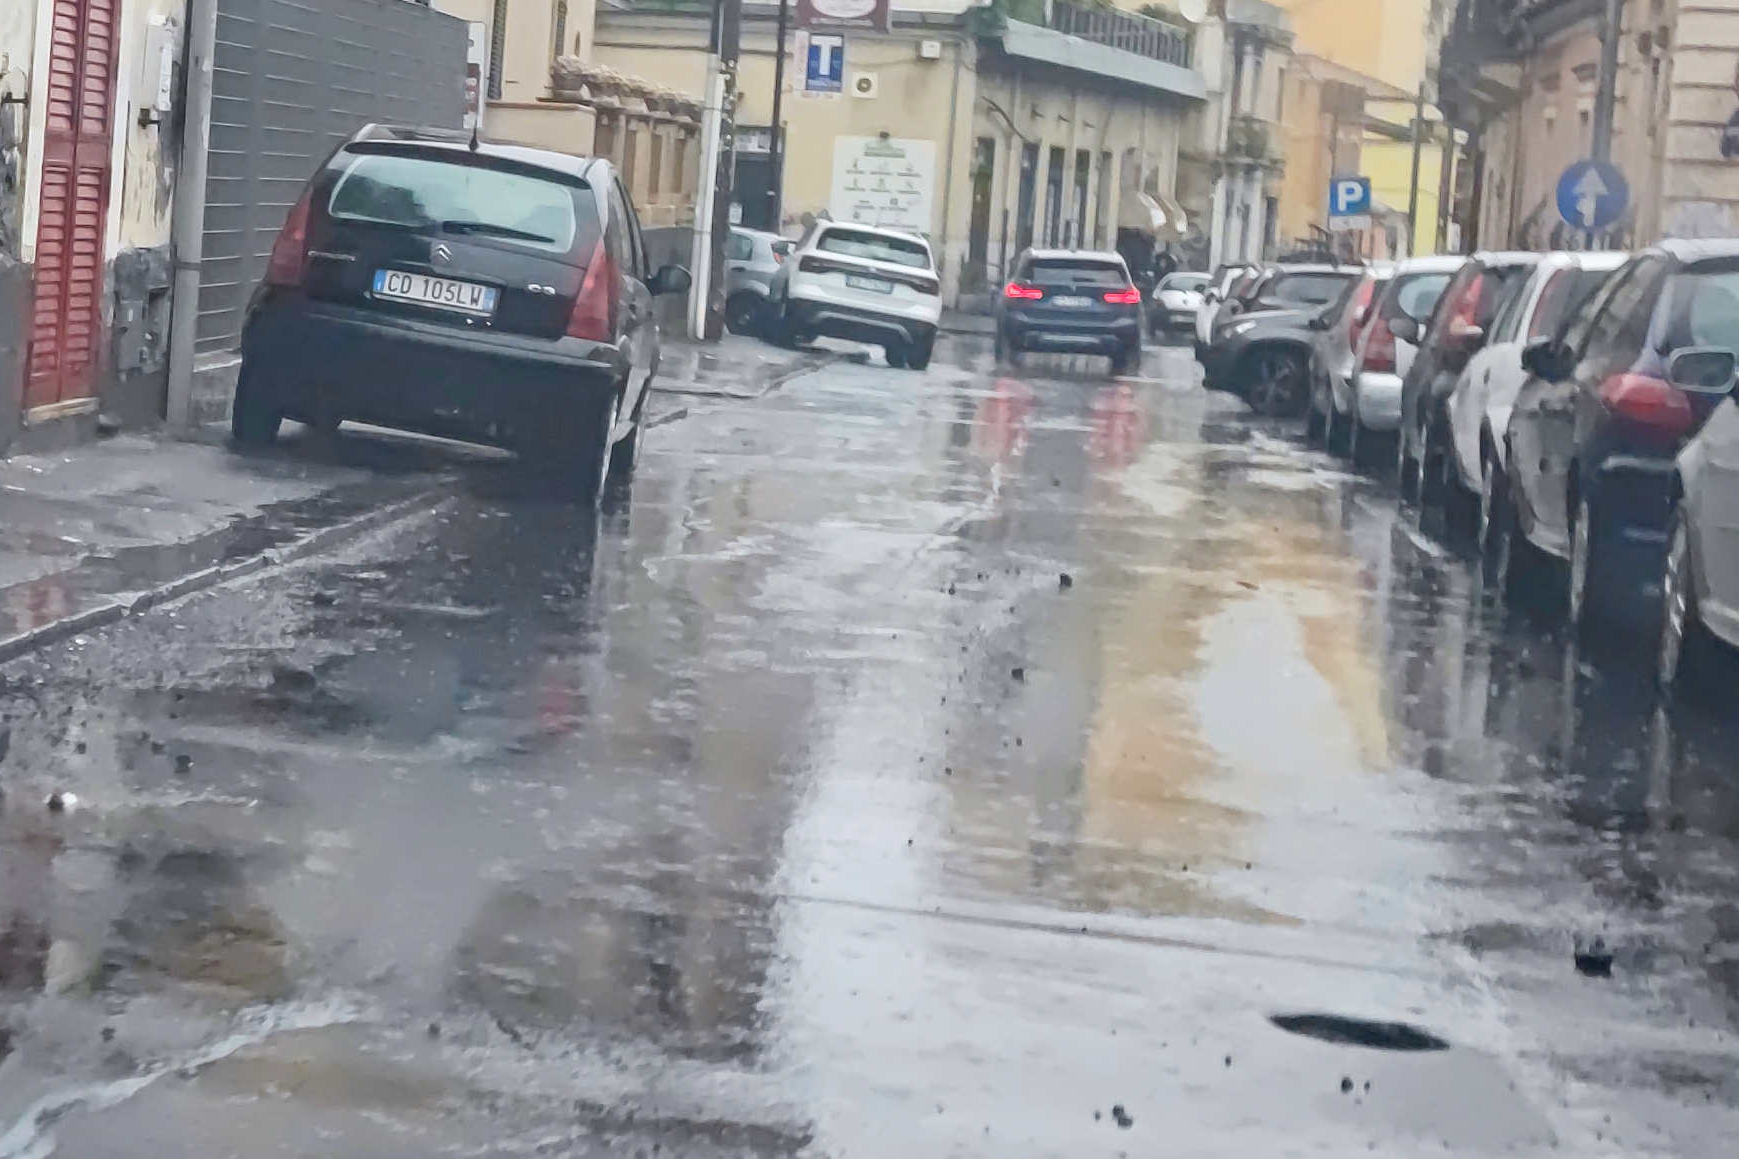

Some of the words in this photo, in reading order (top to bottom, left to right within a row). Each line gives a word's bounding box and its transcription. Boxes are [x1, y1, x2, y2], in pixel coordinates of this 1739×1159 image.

[811, 35, 842, 76] T
[1337, 181, 1363, 211] P
[387, 272, 412, 296] CD
[422, 278, 483, 307] 105LW
